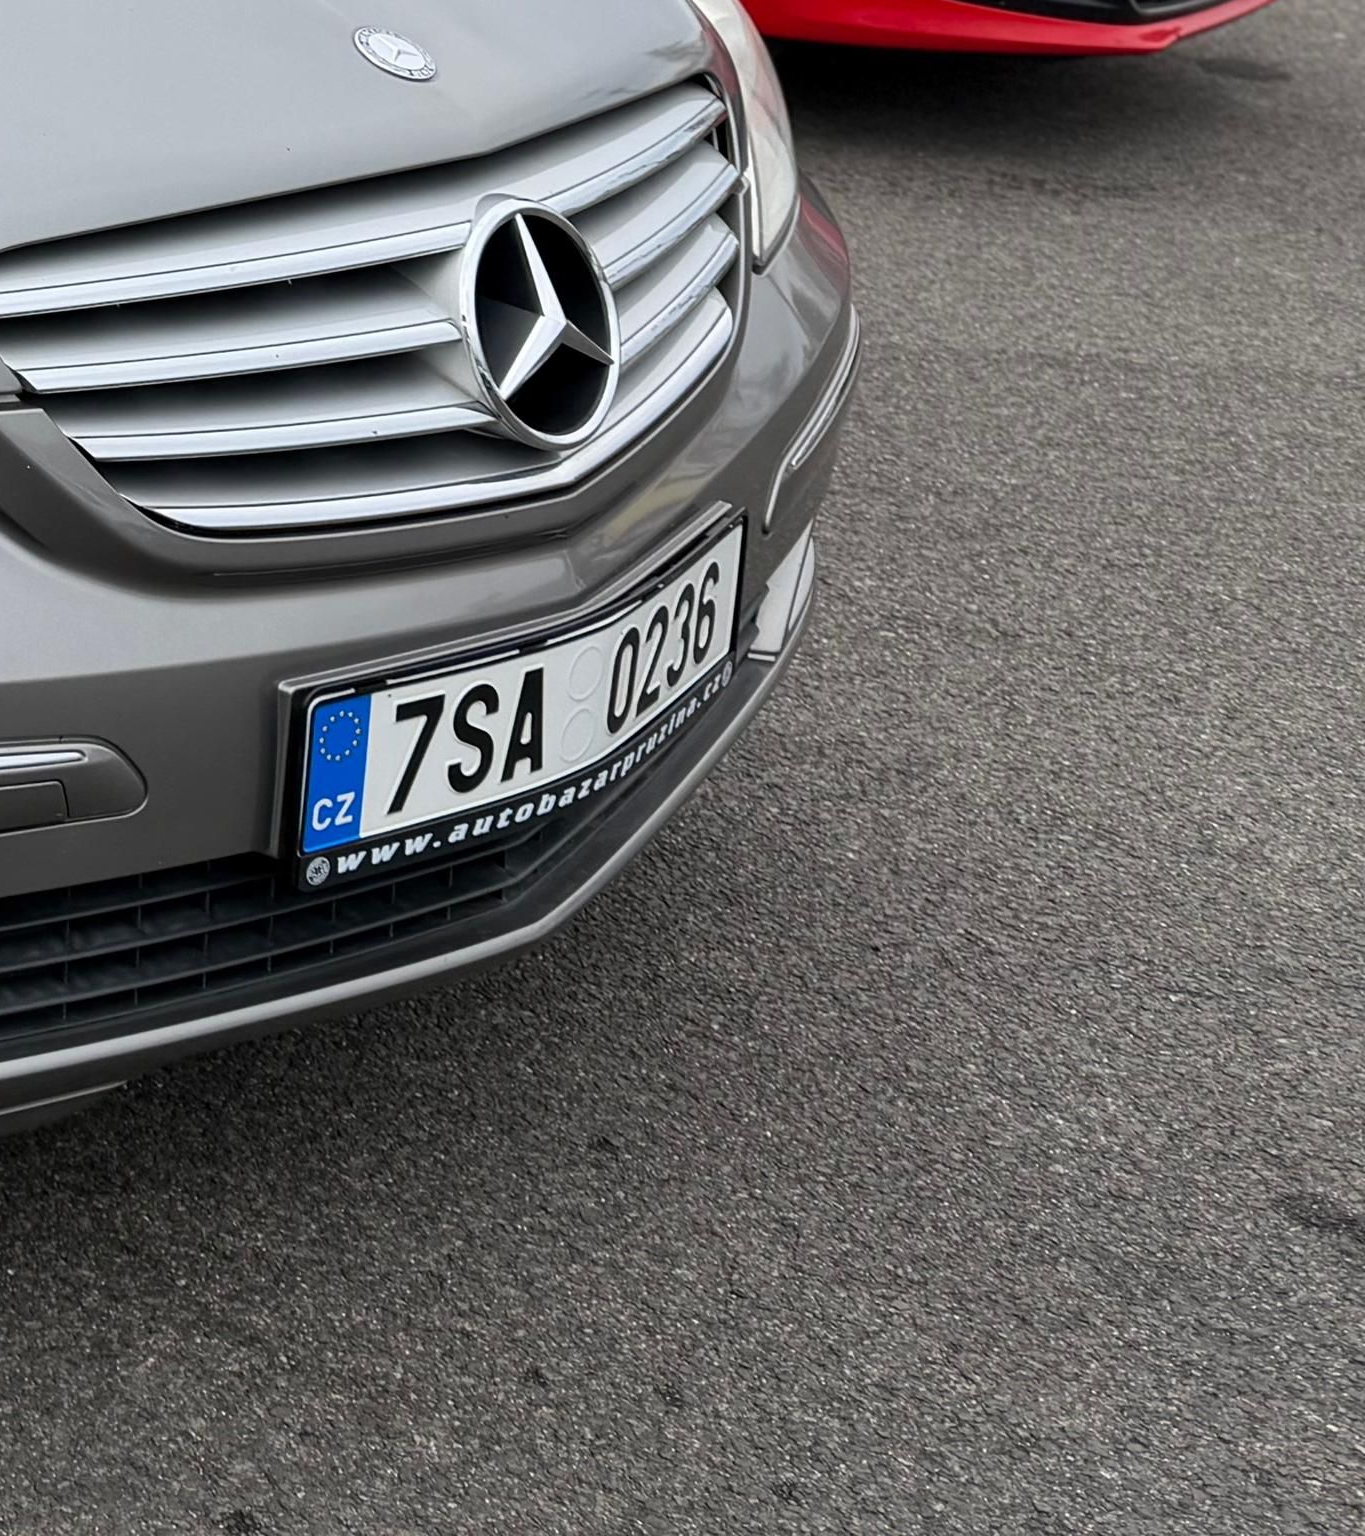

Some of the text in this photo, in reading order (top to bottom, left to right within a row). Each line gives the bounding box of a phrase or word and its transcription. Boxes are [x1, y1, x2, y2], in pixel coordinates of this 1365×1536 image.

[337, 675, 722, 874] www.autobazarpruzina.cz
[387, 561, 721, 815] 7SA 0236
[311, 791, 356, 832] CZ
